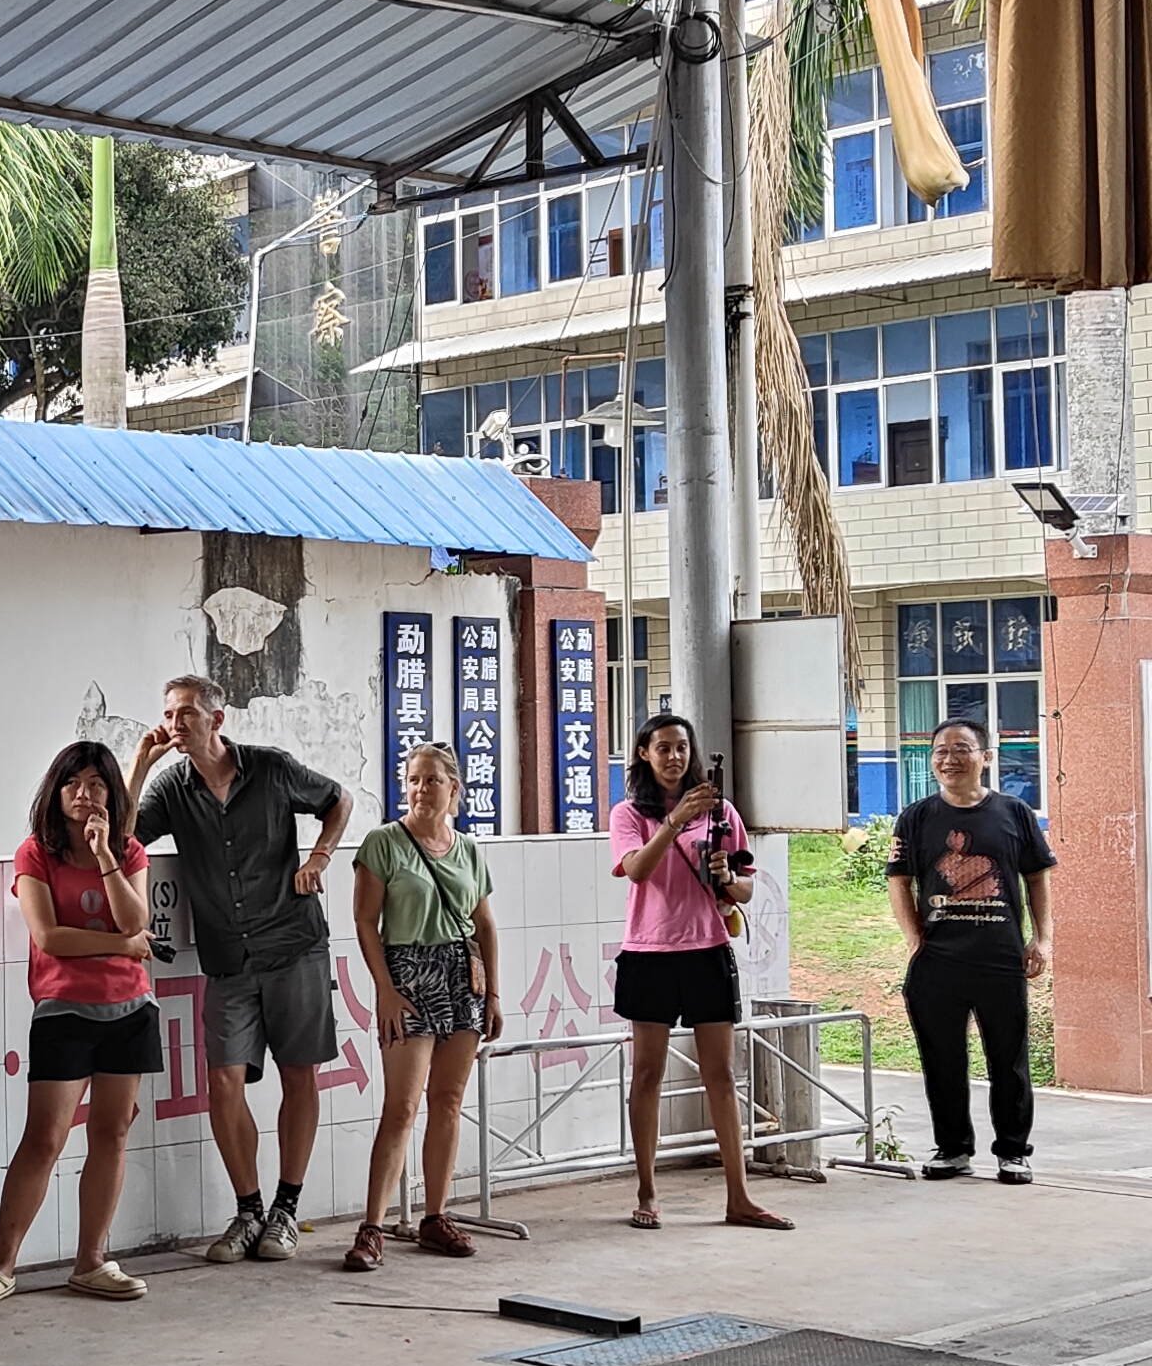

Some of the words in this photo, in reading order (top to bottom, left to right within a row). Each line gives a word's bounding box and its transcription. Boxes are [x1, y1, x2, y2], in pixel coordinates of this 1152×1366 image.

[462, 626, 479, 712] 公安局
[481, 625, 498, 712] 勐腊县
[559, 628, 577, 713] 公安局
[577, 628, 594, 713] 勐腊县
[395, 623, 427, 811] 勐腊县交
